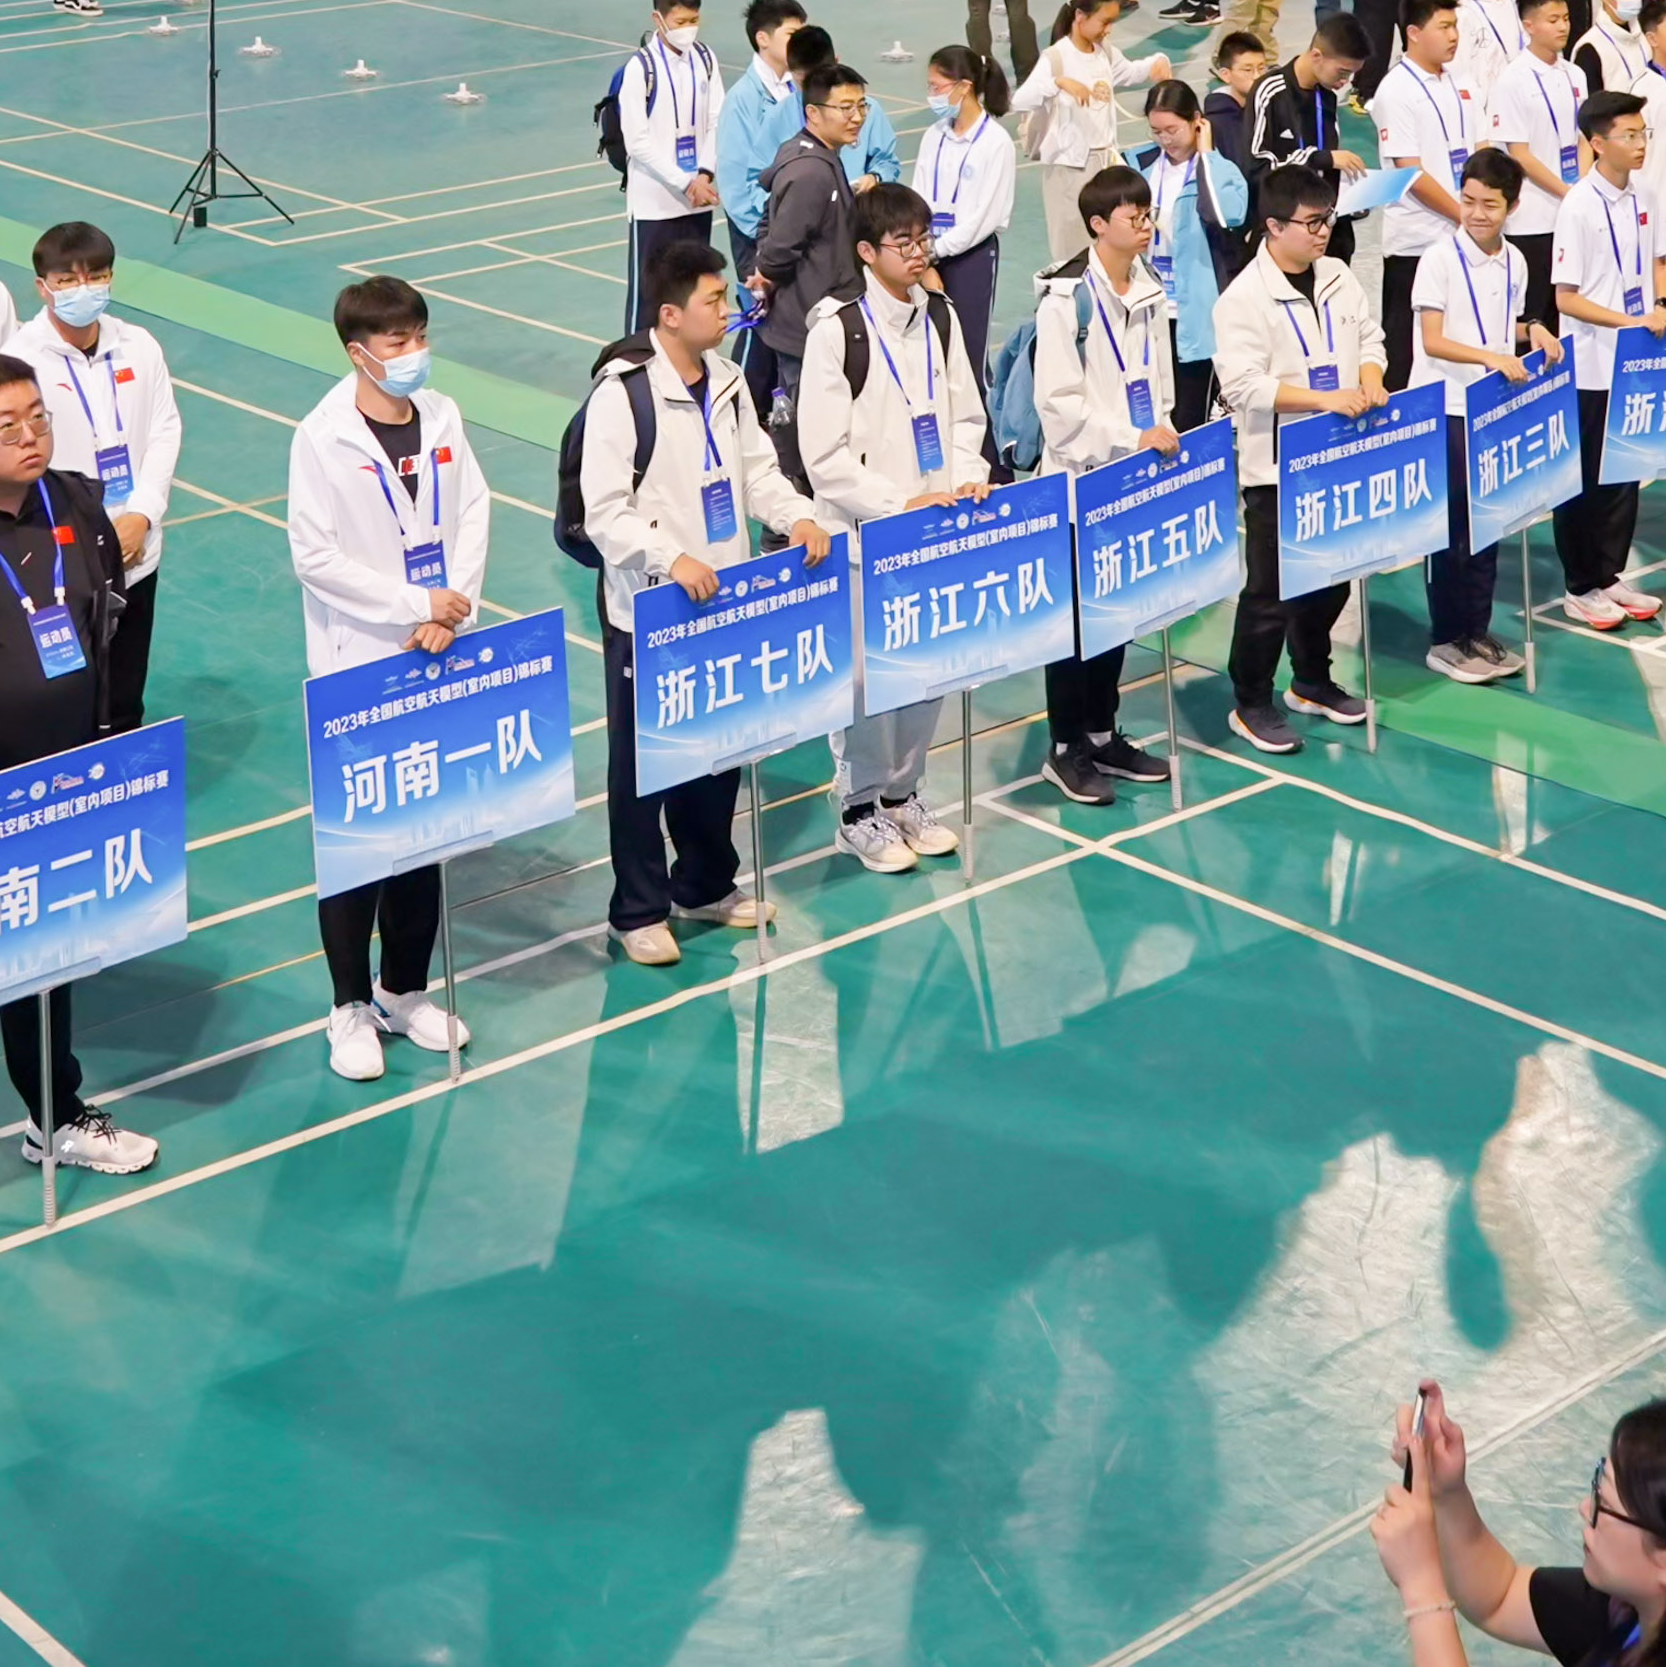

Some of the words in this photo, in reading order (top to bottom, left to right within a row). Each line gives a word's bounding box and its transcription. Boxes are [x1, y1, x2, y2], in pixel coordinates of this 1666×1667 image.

[101, 465, 130, 482] 运动员
[1477, 409, 1571, 499] 浙江三队
[1295, 458, 1433, 543] 浙江四队
[410, 561, 442, 582] 运动员
[1093, 499, 1224, 600] 浙江五队
[40, 626, 74, 649] 运动员
[647, 576, 839, 649] 2023年全国航空航天模型(室内项目)锦标赛
[882, 557, 1054, 653] 浙江六队
[323, 655, 553, 738] 2023年全国航空航天模型(室内项目)锦标赛
[656, 623, 834, 730] 浙江七队
[342, 709, 542, 823] 河南一队
